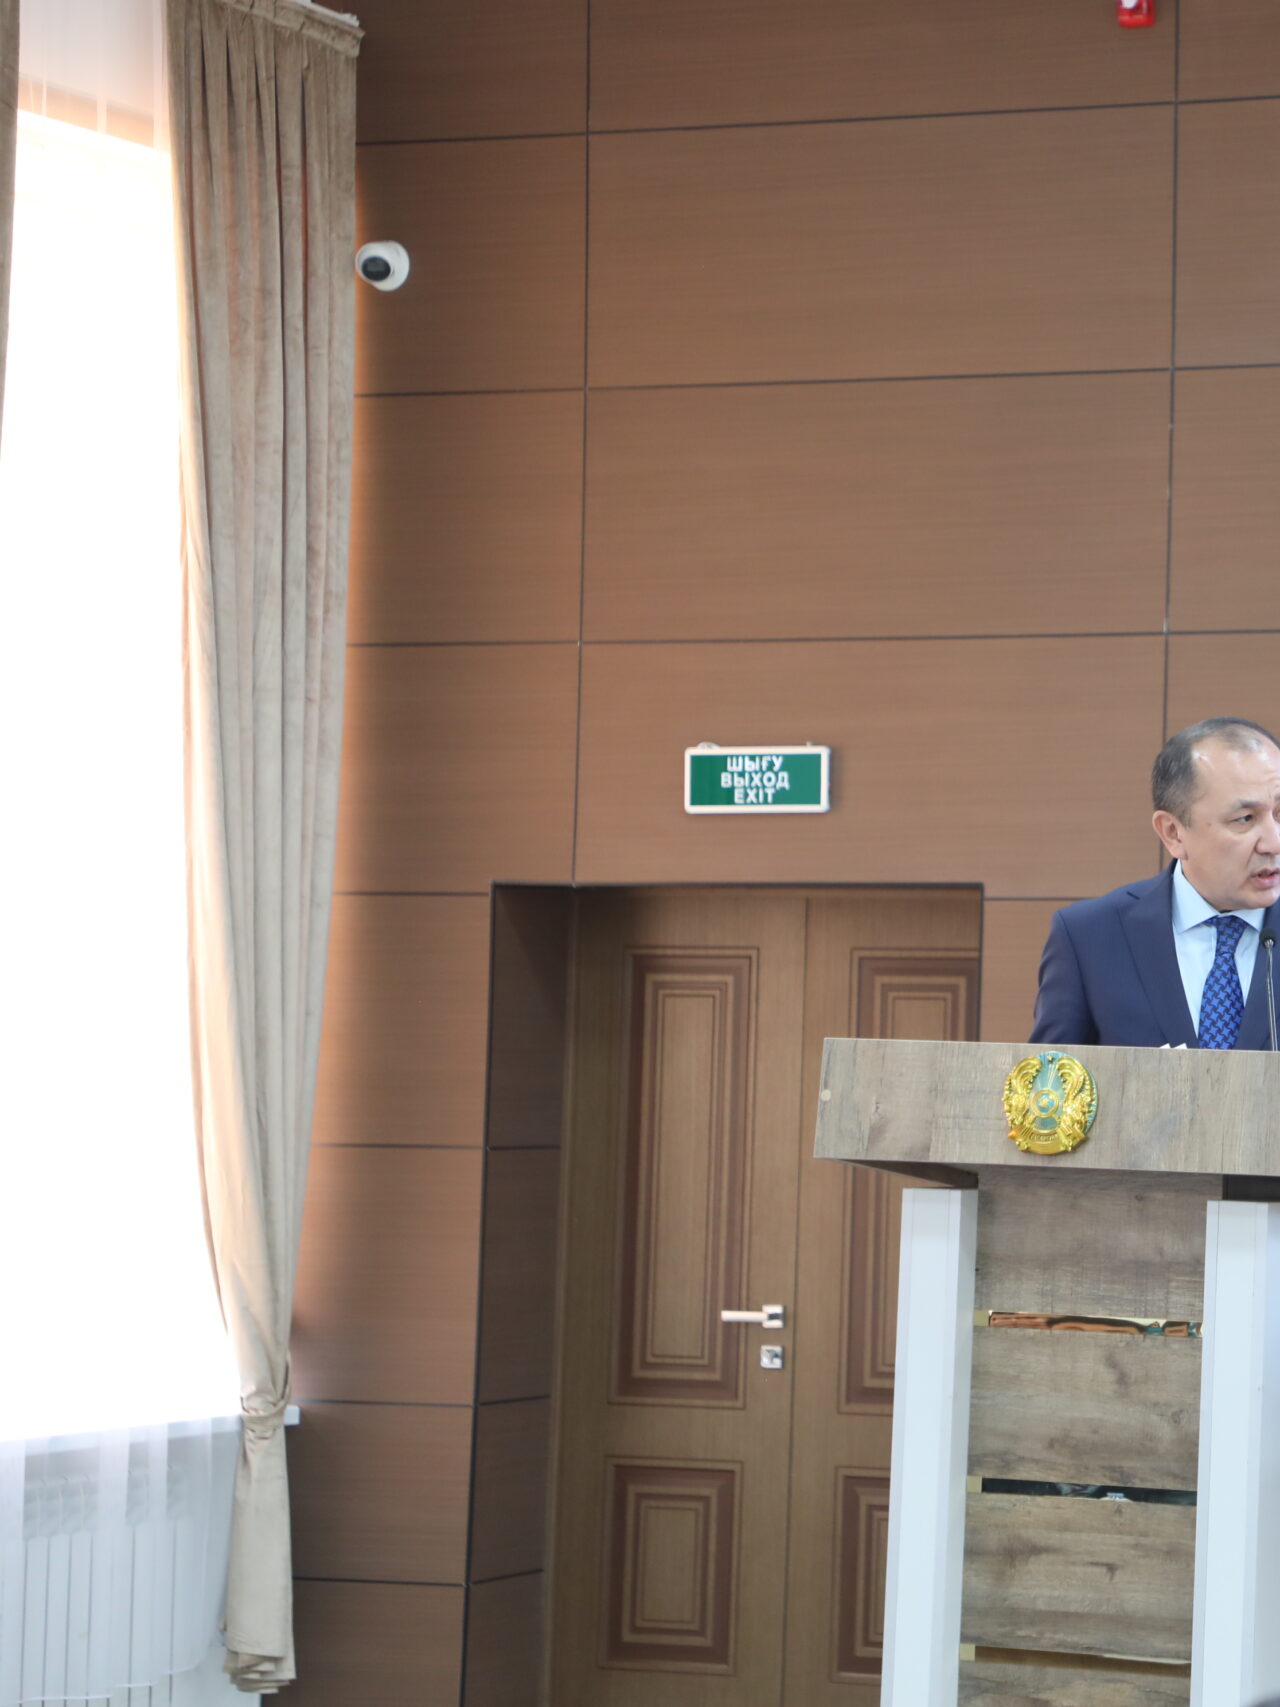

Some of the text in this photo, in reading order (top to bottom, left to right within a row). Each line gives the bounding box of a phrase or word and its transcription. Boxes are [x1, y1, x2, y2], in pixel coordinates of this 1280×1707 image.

[727, 756, 784, 772] ШЫҒУ
[721, 771, 790, 790] ВЫХОД
[734, 788, 776, 804] EXIT
